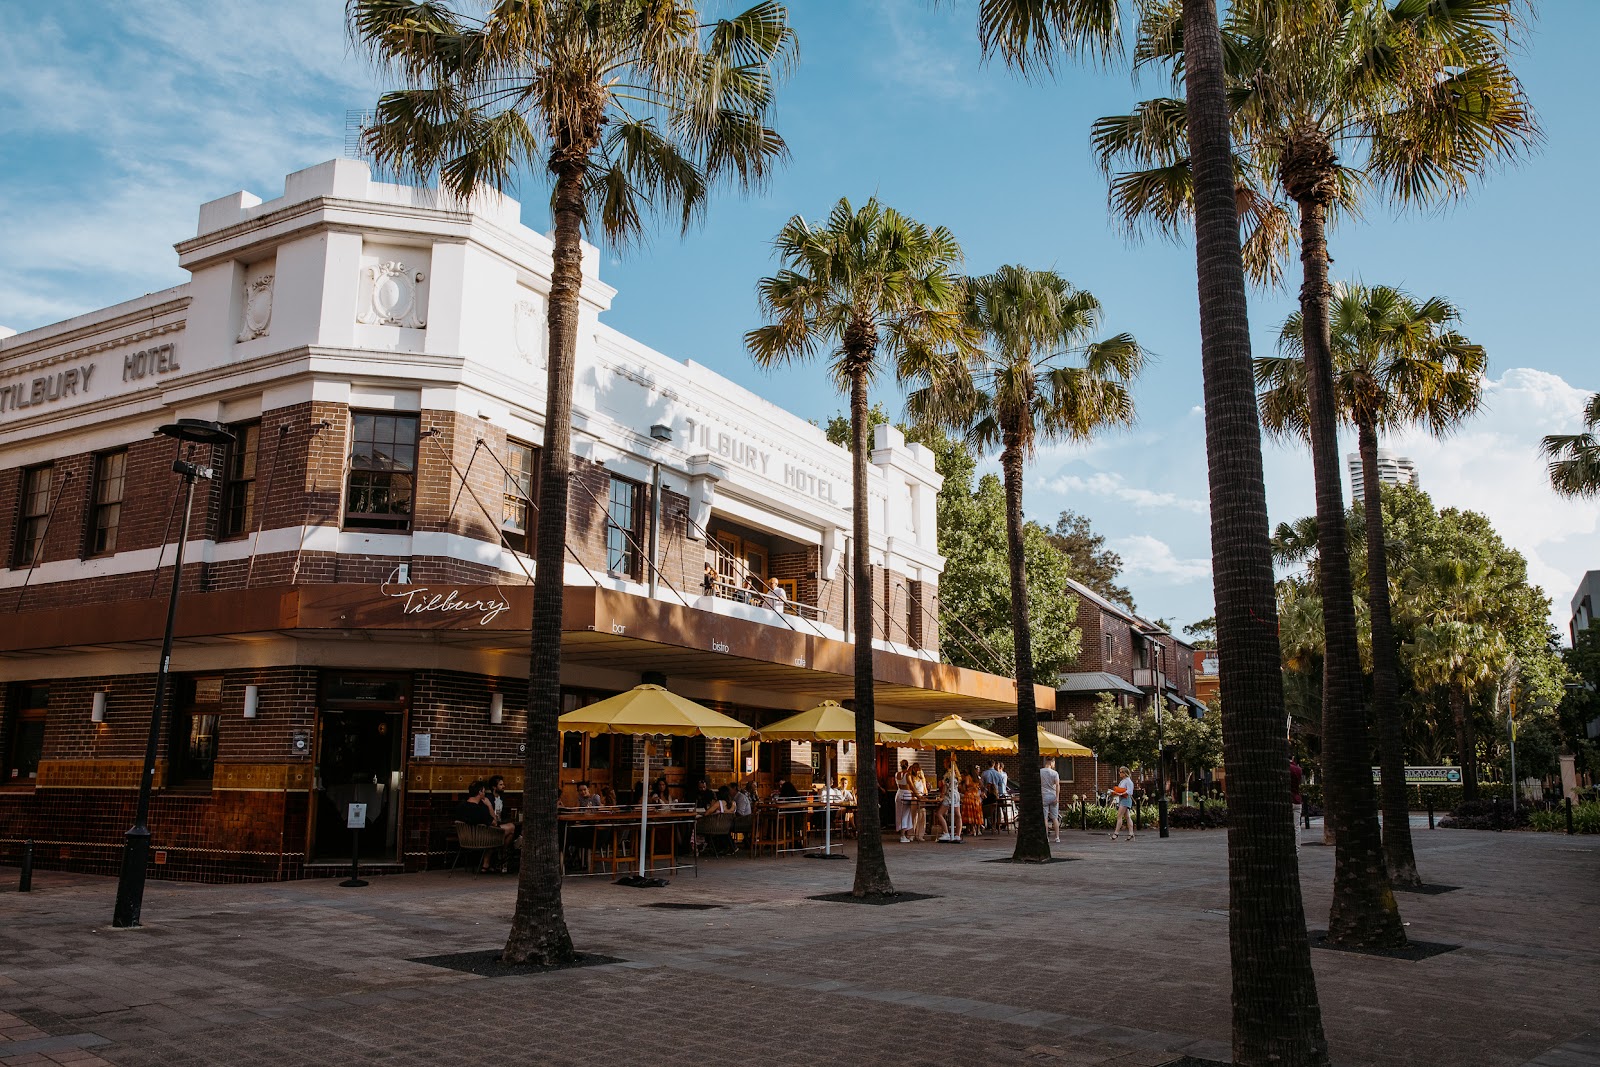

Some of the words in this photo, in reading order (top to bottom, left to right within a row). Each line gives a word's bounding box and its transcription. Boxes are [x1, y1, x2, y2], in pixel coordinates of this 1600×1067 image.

[0, 363, 95, 414] TILBURY
[122, 342, 180, 382] HOTEL
[686, 417, 771, 474] TILBURY
[784, 463, 838, 505] HOTEL
[391, 587, 510, 625] Tilbury
[612, 619, 626, 634] bar
[712, 638, 730, 653] bistro
